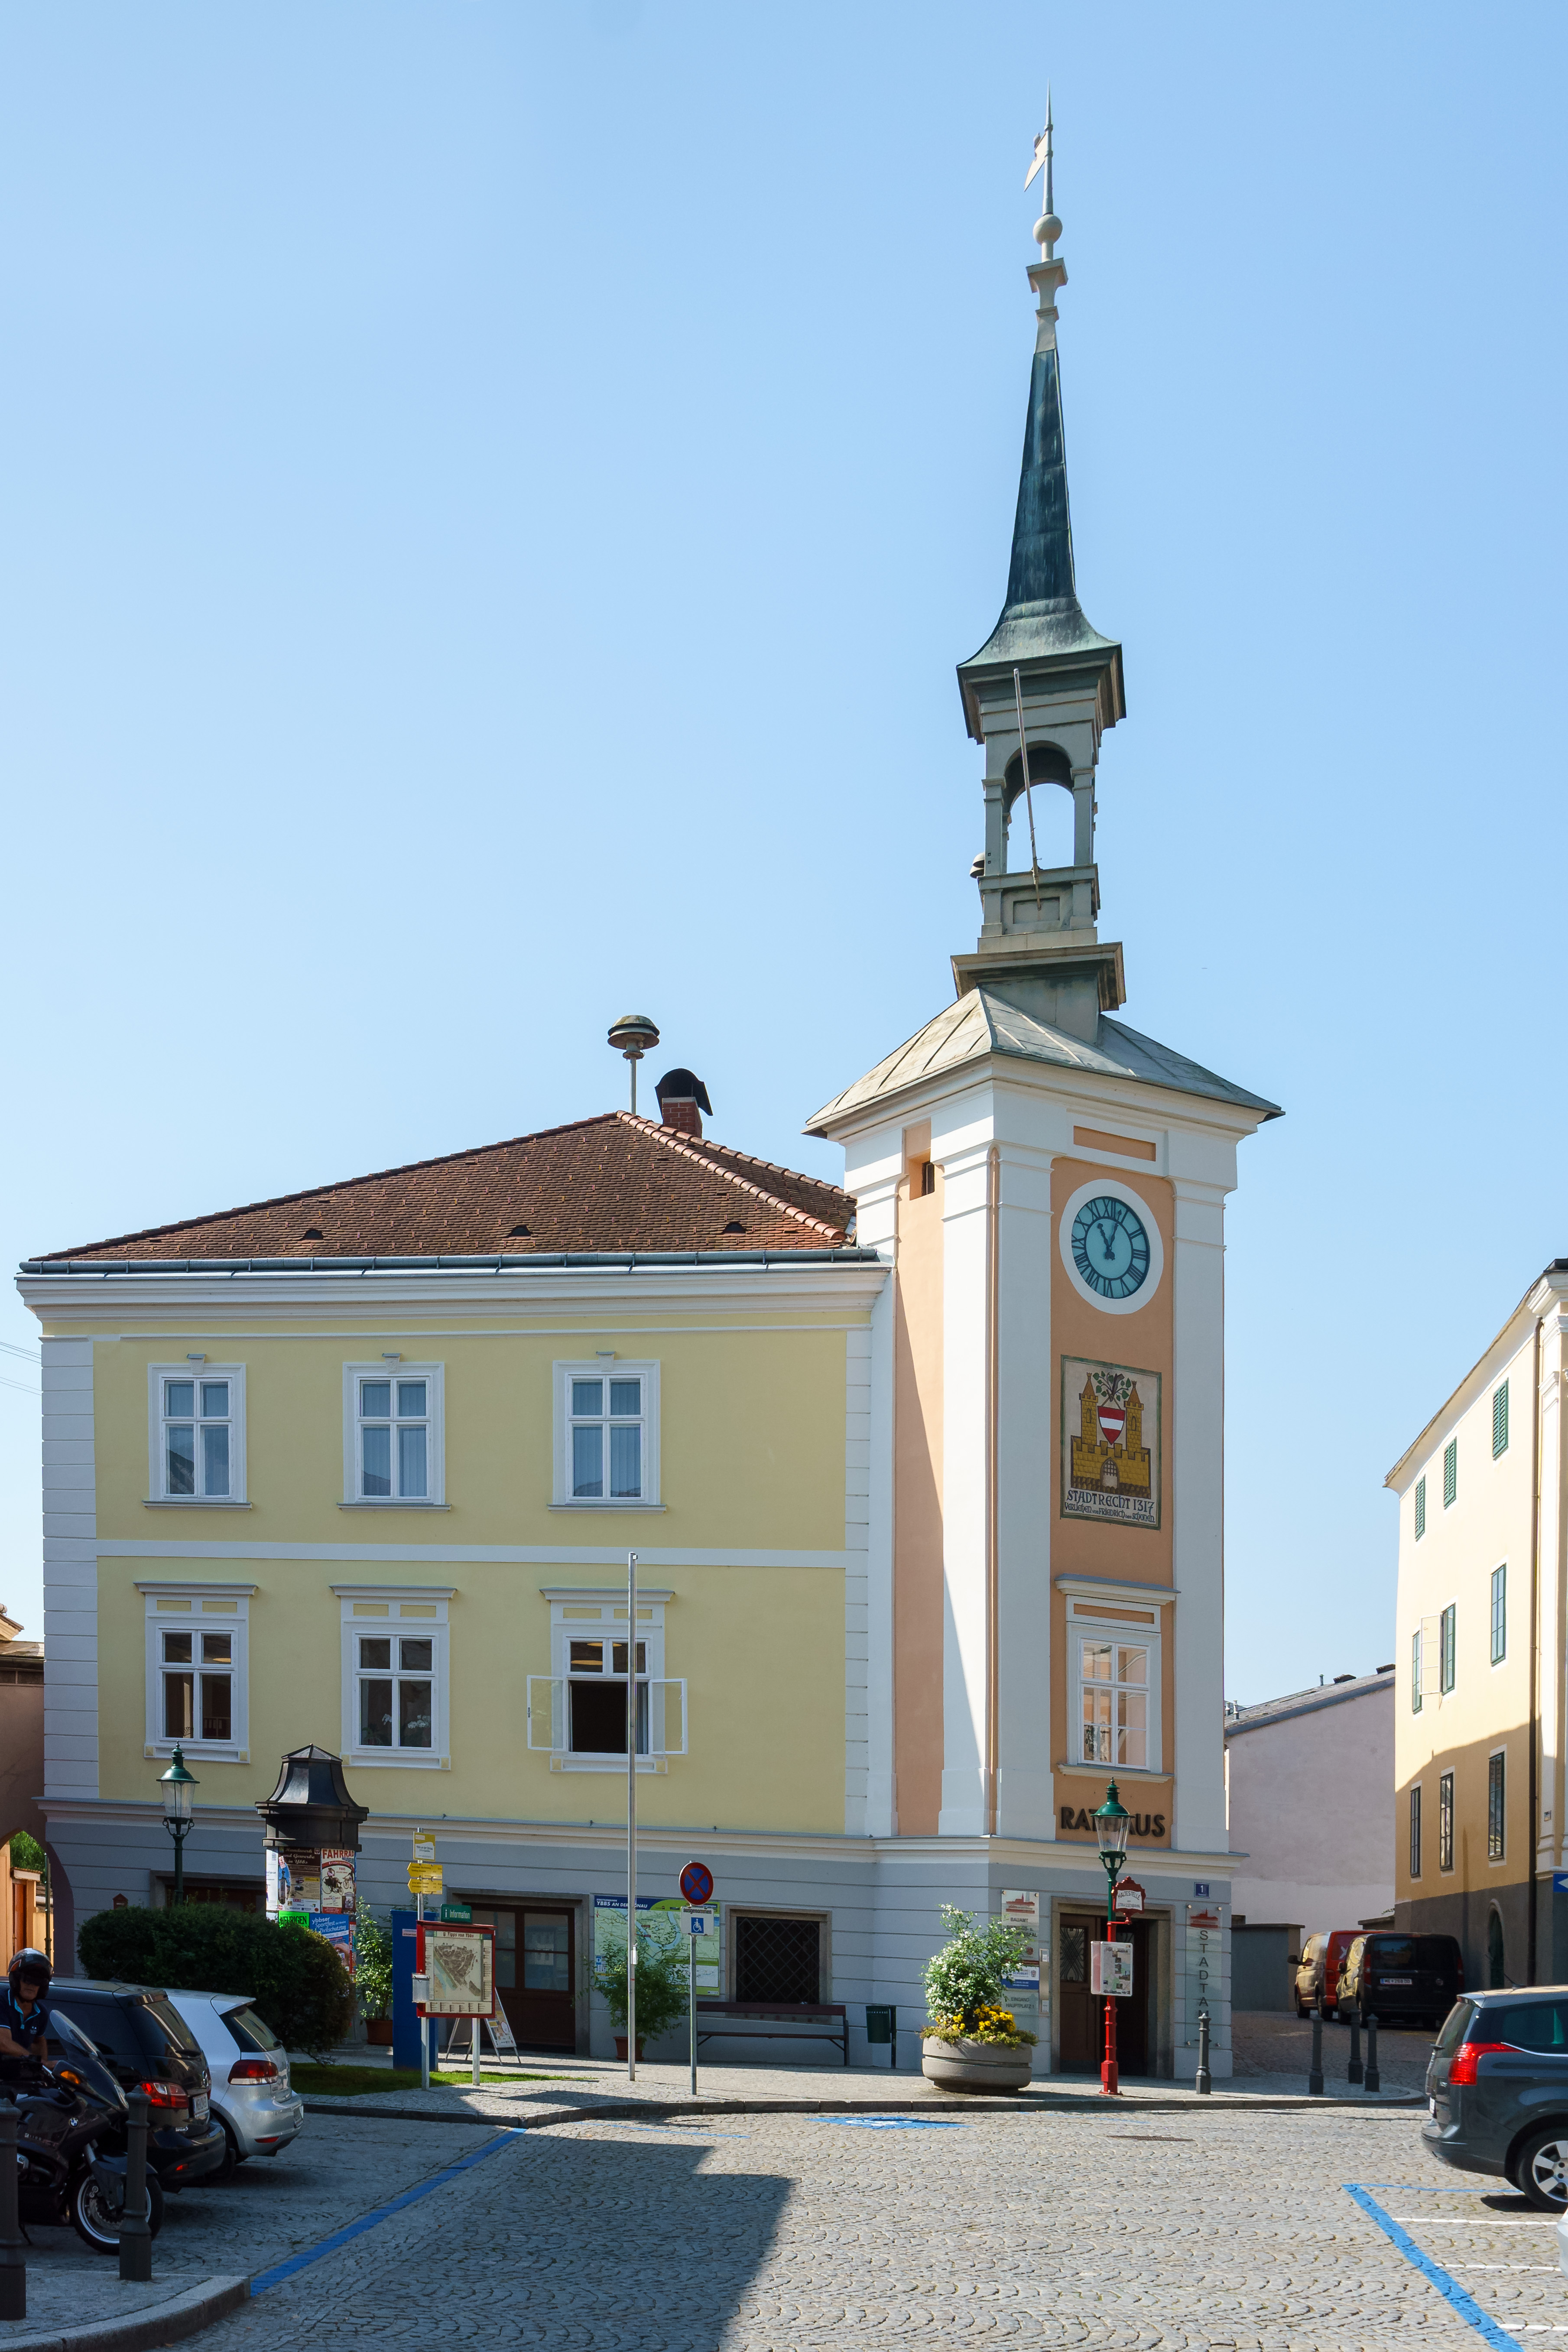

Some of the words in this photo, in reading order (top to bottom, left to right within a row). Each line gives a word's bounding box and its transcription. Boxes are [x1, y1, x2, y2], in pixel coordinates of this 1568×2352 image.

[1066, 1489, 1130, 1509] STADTRECHT
[1133, 1499, 1155, 1515] 1317
[322, 1849, 354, 1859] FAHRRAD
[1118, 1891, 1140, 1900] HALTESTELLE
[450, 1909, 470, 1919] Information
